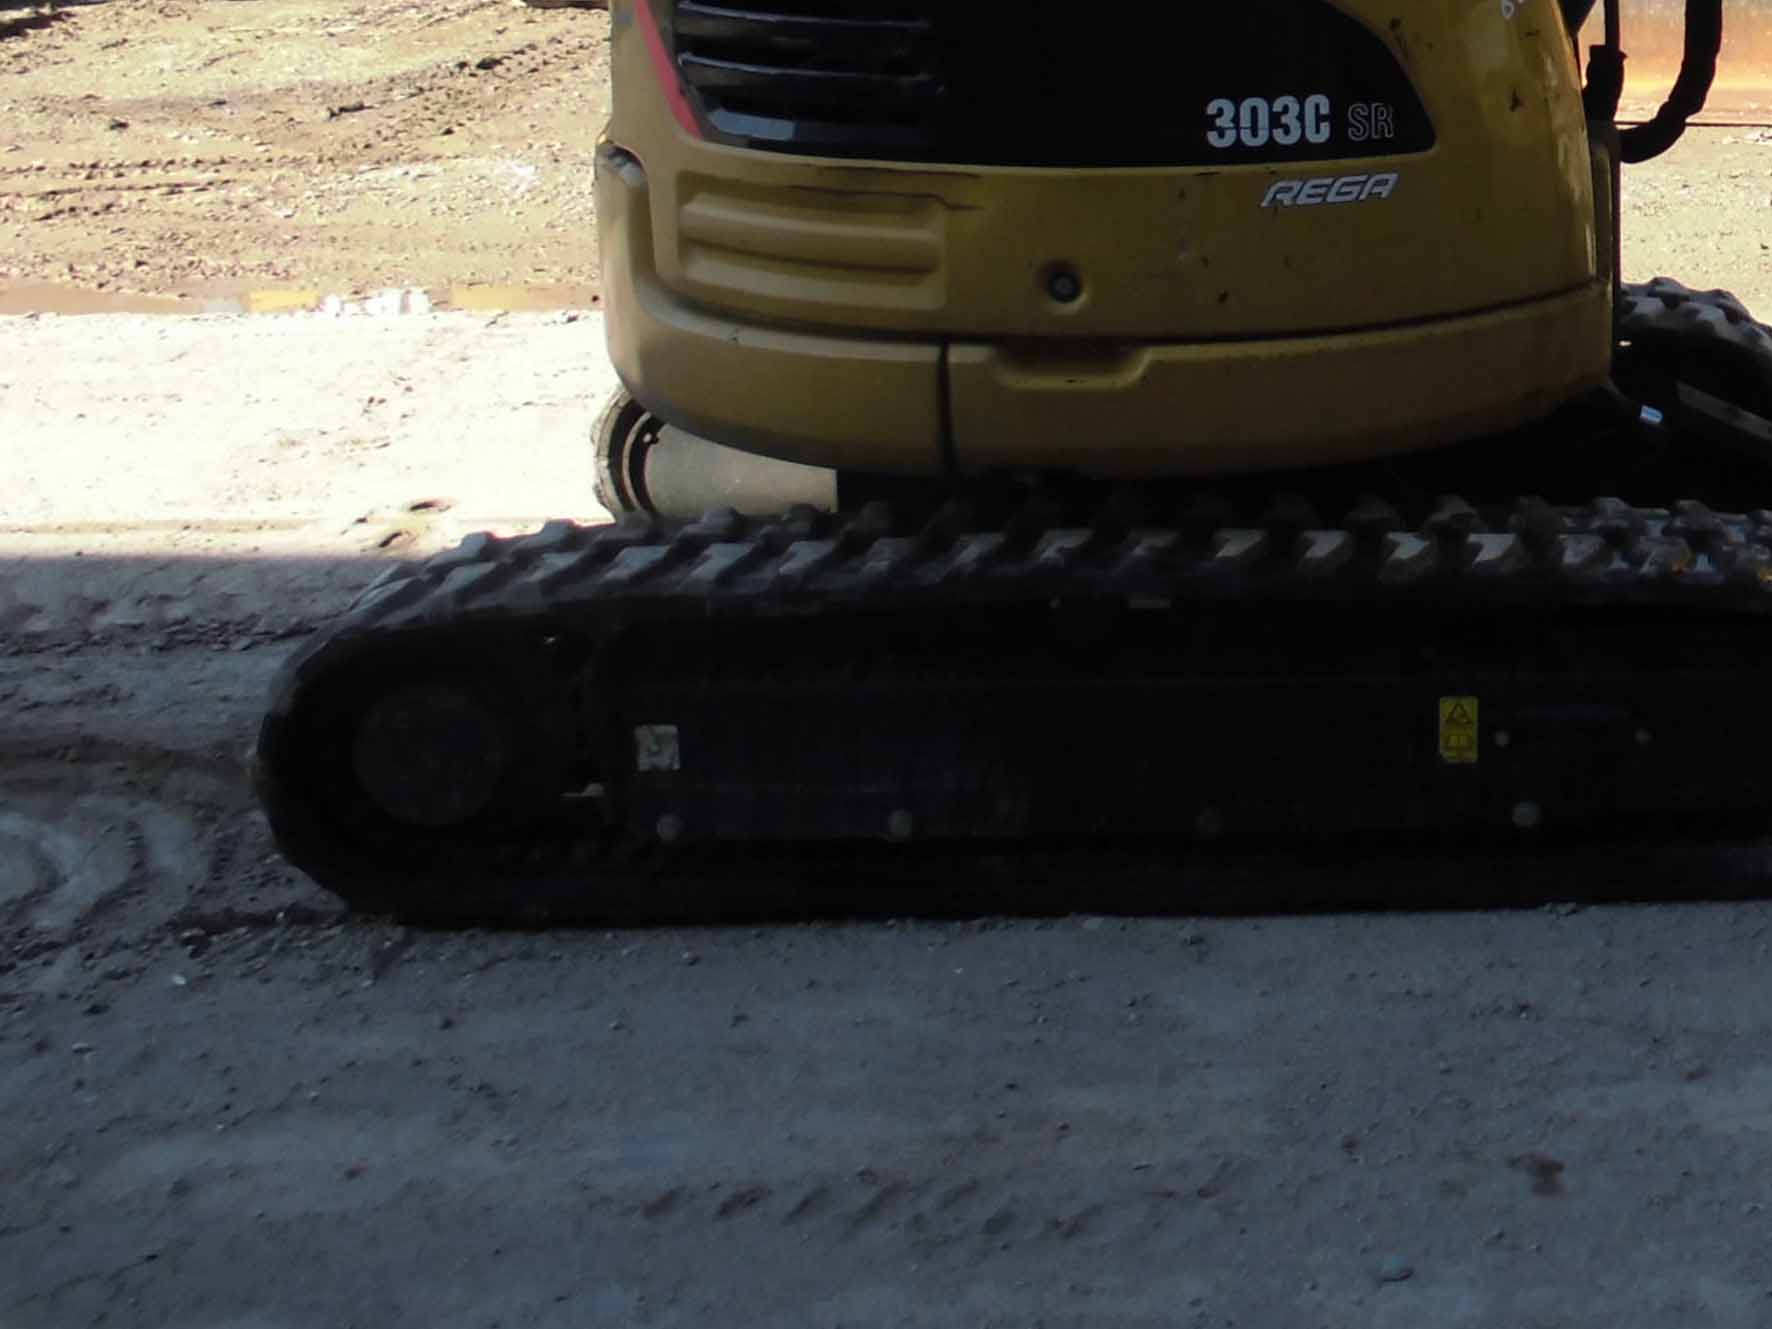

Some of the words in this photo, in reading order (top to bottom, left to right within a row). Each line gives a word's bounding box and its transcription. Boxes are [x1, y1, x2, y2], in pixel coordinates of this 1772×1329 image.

[1206, 94, 1331, 148] 303C
[1347, 102, 1394, 142] SR
[1260, 173, 1399, 207] REGA
